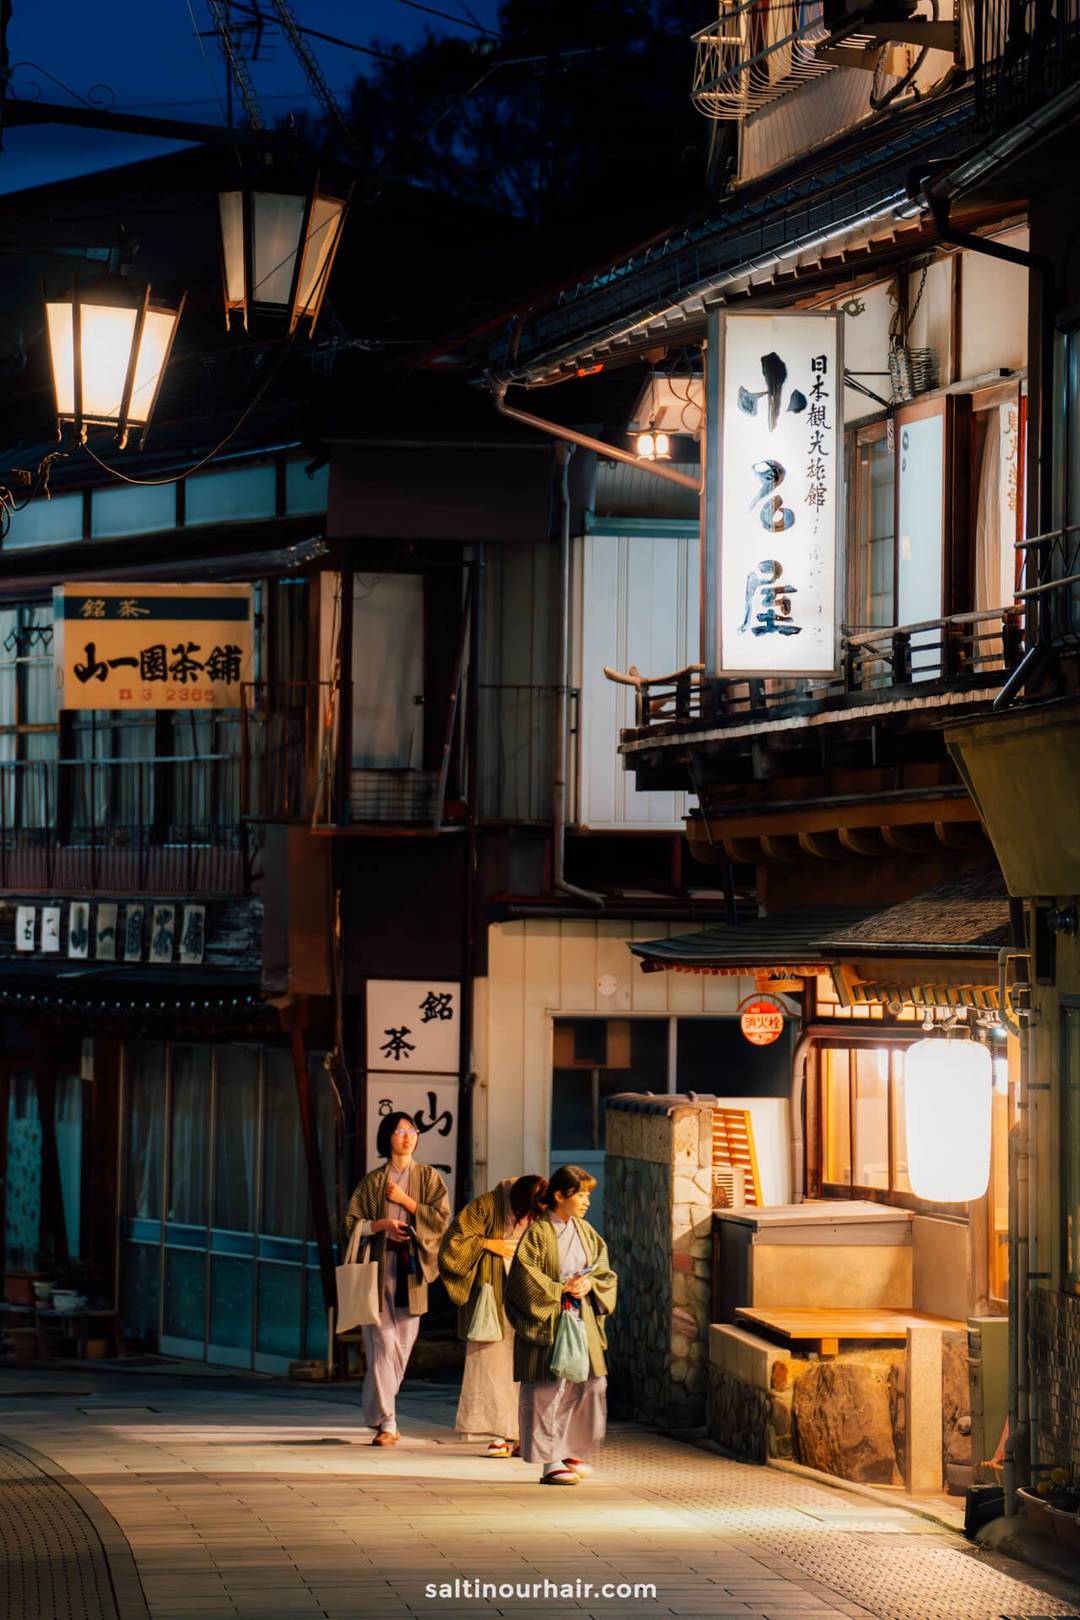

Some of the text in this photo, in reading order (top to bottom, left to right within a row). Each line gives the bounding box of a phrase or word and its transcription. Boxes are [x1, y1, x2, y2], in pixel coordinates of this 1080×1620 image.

[80, 599, 150, 618] 銘茶
[744, 1016, 781, 1030] 消火栓
